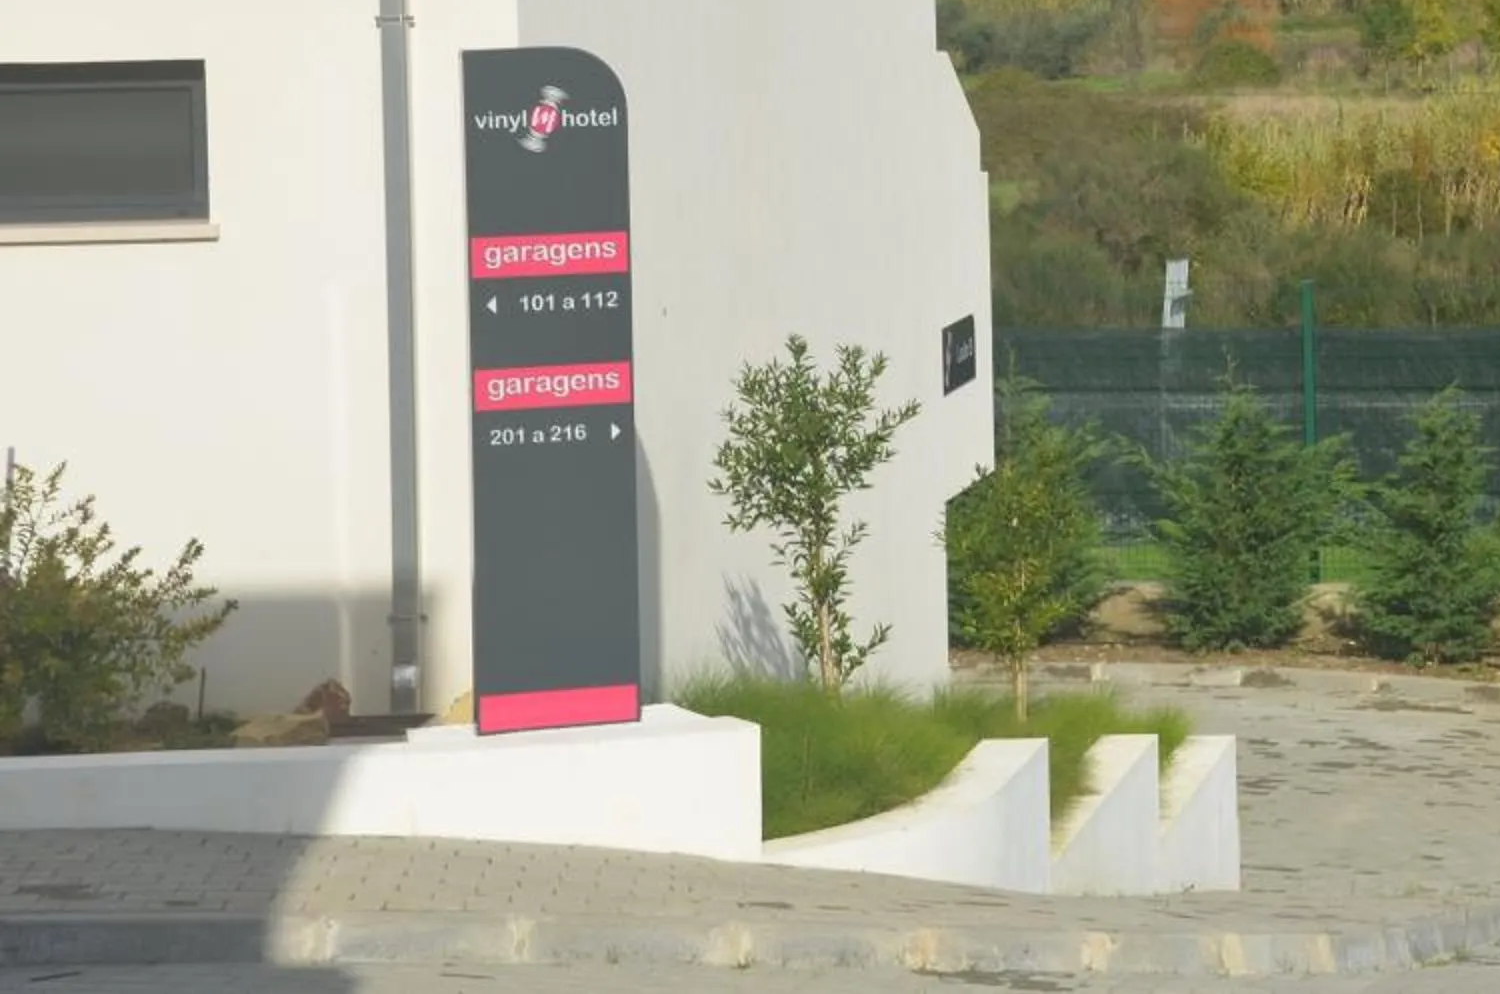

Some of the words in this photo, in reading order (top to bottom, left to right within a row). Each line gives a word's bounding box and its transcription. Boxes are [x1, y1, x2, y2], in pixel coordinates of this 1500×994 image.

[474, 110, 527, 133] vinyl
[561, 107, 618, 128] hotel
[484, 240, 618, 269] garagens
[519, 294, 555, 314] 101
[562, 295, 576, 310] a
[581, 291, 619, 309] 112
[487, 371, 620, 401] garagens
[490, 427, 526, 446] 201
[532, 429, 545, 444] a
[550, 423, 588, 442] 216
